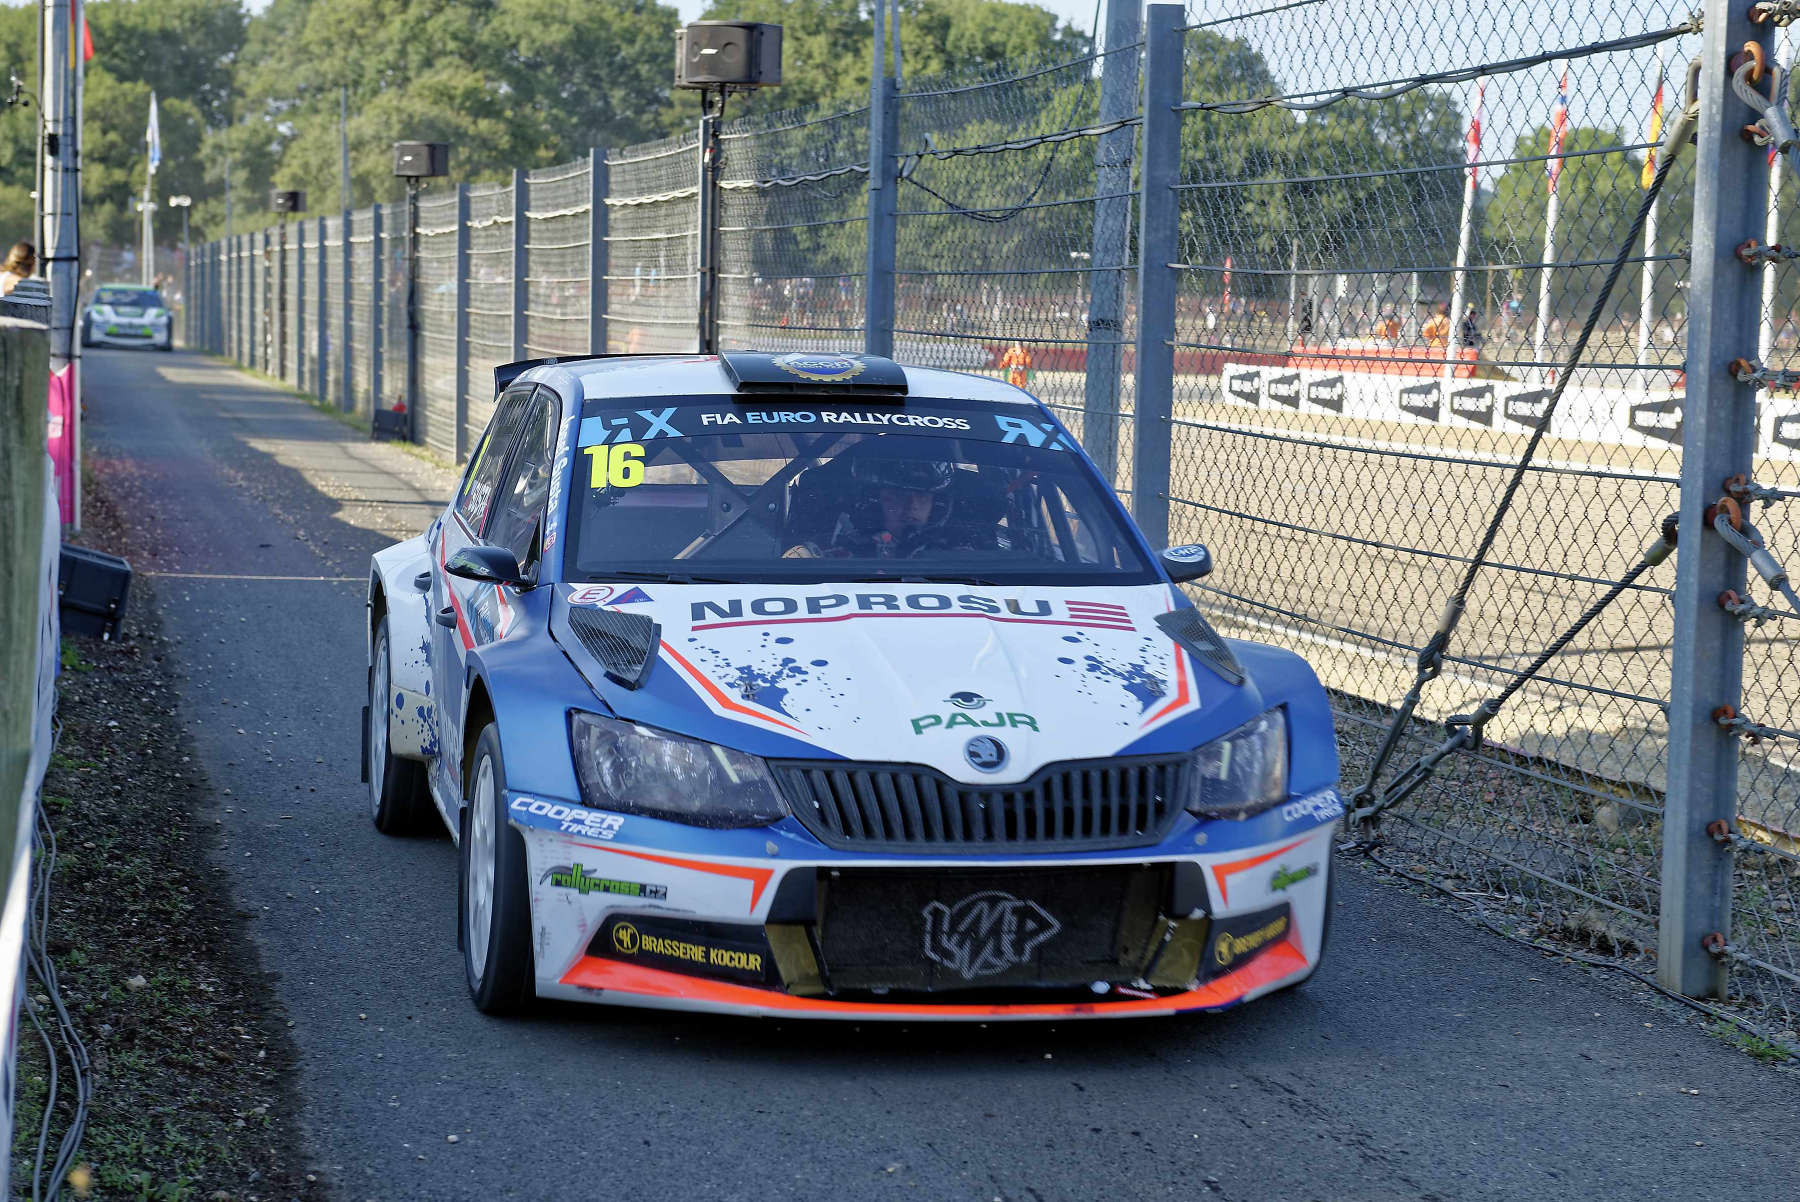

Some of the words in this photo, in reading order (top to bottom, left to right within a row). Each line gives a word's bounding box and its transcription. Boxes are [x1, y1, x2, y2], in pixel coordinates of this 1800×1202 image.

[701, 412, 742, 426] FIA
[746, 411, 817, 425] EURO
[820, 410, 972, 431] RALLYCROSS
[583, 443, 646, 490] 16
[690, 592, 1053, 623] NOPROSU
[910, 711, 1040, 736] PAJR
[508, 795, 625, 832] COOPER
[558, 820, 617, 841] TIRES
[550, 862, 668, 901] rallycross.cz
[641, 934, 707, 963] BRASSERIE
[709, 946, 763, 973] KOCOUR
